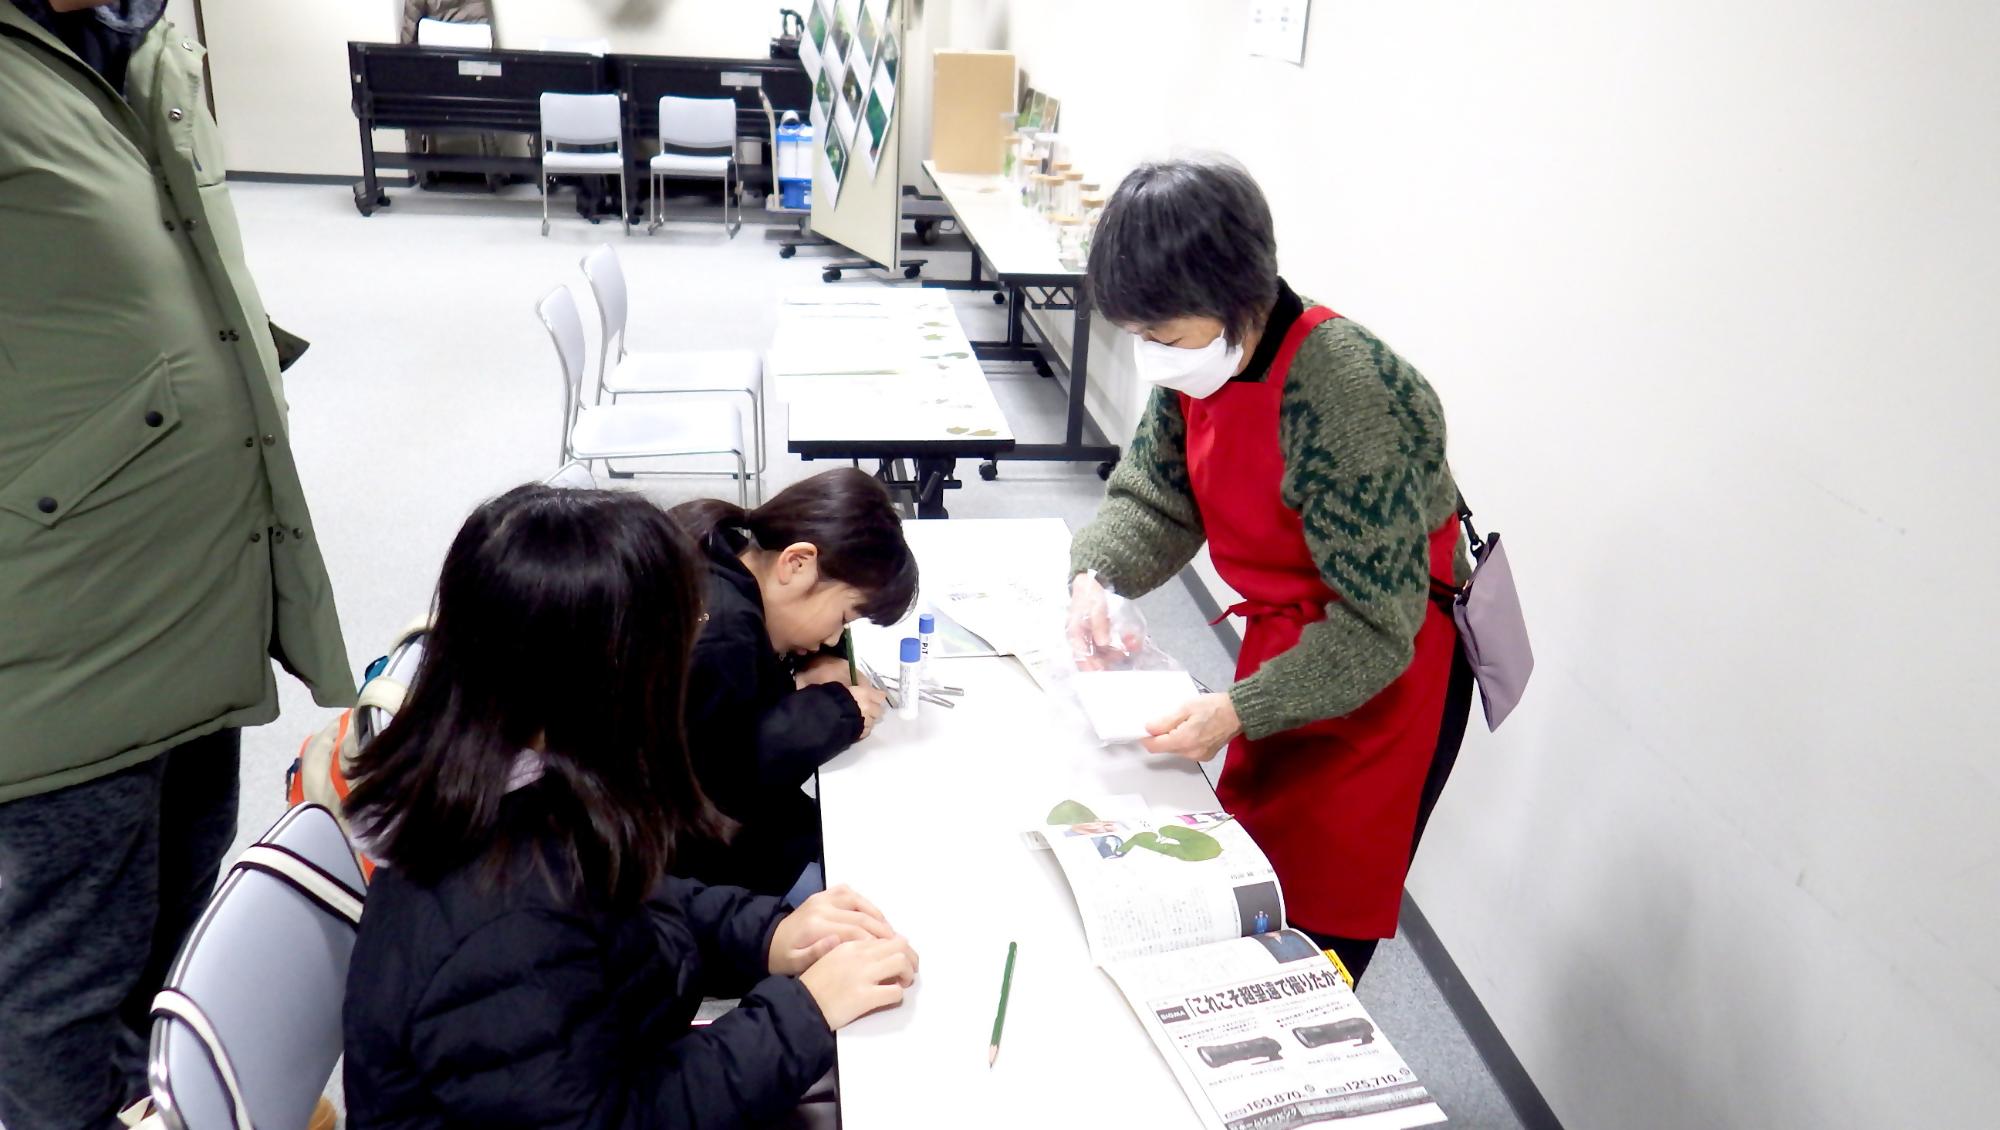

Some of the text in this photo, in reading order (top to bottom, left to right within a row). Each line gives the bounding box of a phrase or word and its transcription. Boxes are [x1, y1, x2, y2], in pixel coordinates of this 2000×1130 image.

[1185, 969, 1338, 1017] 「これこそ超望遠で撮りたか
